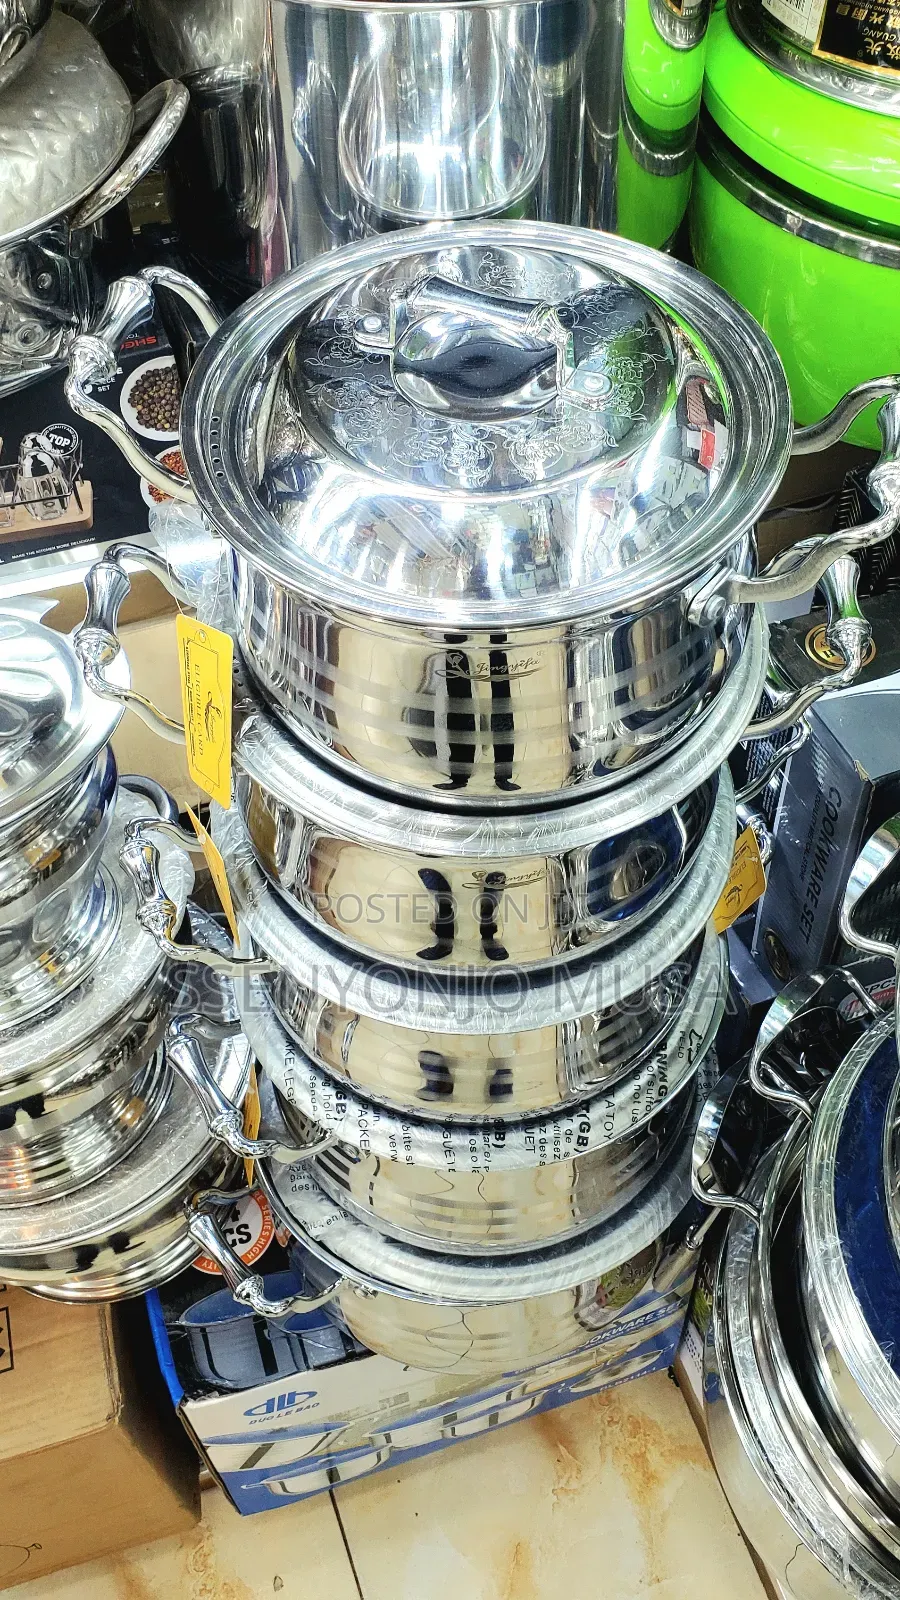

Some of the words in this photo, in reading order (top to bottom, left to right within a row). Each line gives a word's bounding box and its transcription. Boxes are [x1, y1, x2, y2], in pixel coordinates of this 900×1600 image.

[97, 385, 111, 393] SET
[49, 433, 71, 447] TOP
[806, 786, 843, 910] COOKWARE
[799, 903, 815, 945] SET
[646, 1065, 656, 1079] of
[632, 1084, 642, 1105] not
[603, 1112, 615, 1140] TOY
[291, 1183, 310, 1193] des
[261, 1204, 272, 1236] SERIES
[246, 1238, 267, 1259] HIGH
[249, 1414, 275, 1426] DUO
[277, 1409, 293, 1419] LE
[295, 1402, 320, 1414] BAO
